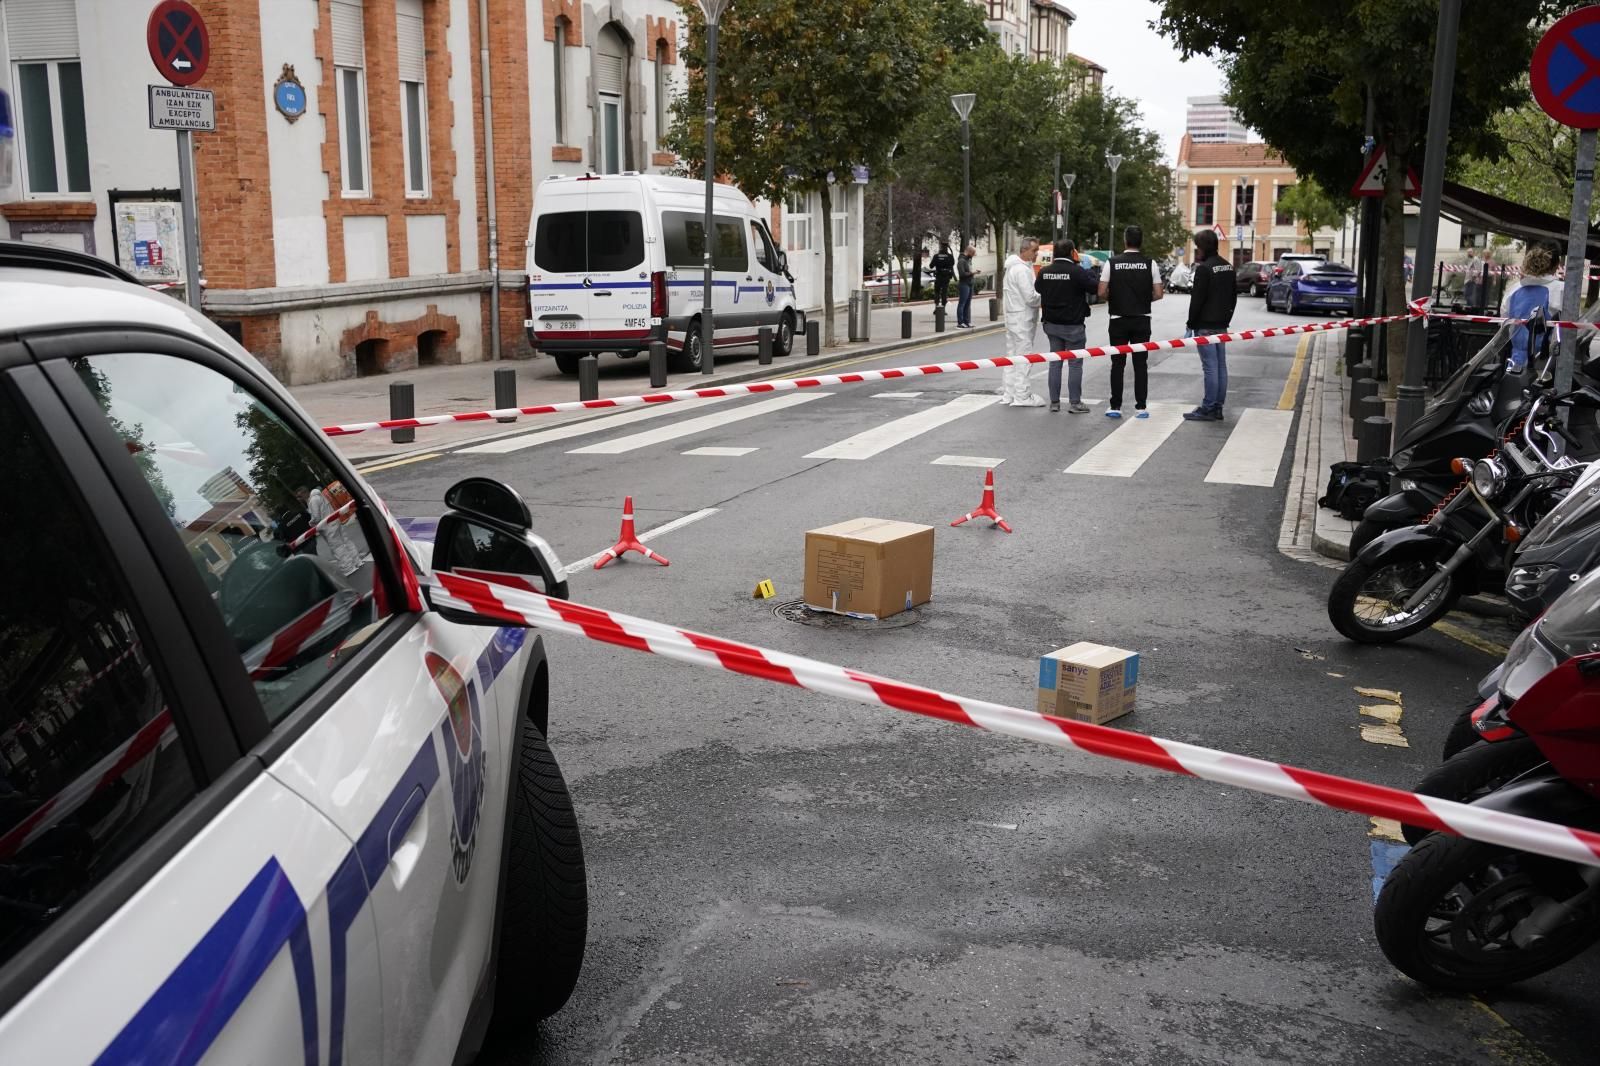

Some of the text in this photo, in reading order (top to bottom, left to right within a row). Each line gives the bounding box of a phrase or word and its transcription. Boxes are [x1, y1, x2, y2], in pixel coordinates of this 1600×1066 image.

[155, 89, 210, 100] ANBULANTZIAK
[166, 99, 184, 107] IZAN
[168, 109, 201, 118] EXCEPTO
[158, 118, 210, 128] AMBULANCIAS
[1114, 262, 1148, 270] ERTZAINTZA
